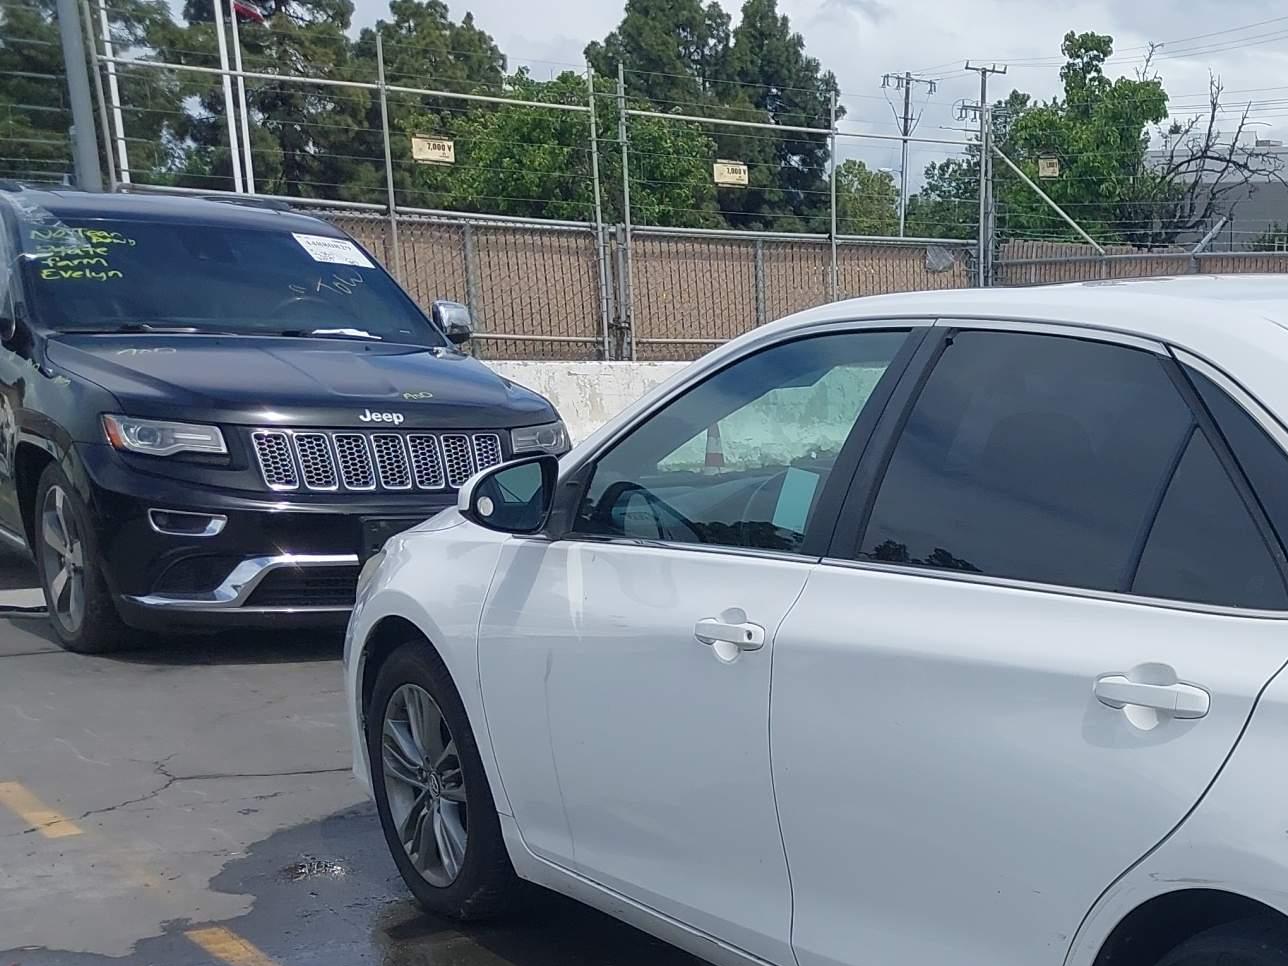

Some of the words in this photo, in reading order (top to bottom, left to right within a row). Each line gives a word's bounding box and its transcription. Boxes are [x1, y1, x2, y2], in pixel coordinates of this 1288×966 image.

[427, 142, 446, 152] 7,000
[40, 268, 124, 282] Evelyn
[359, 408, 405, 425] Jeep
